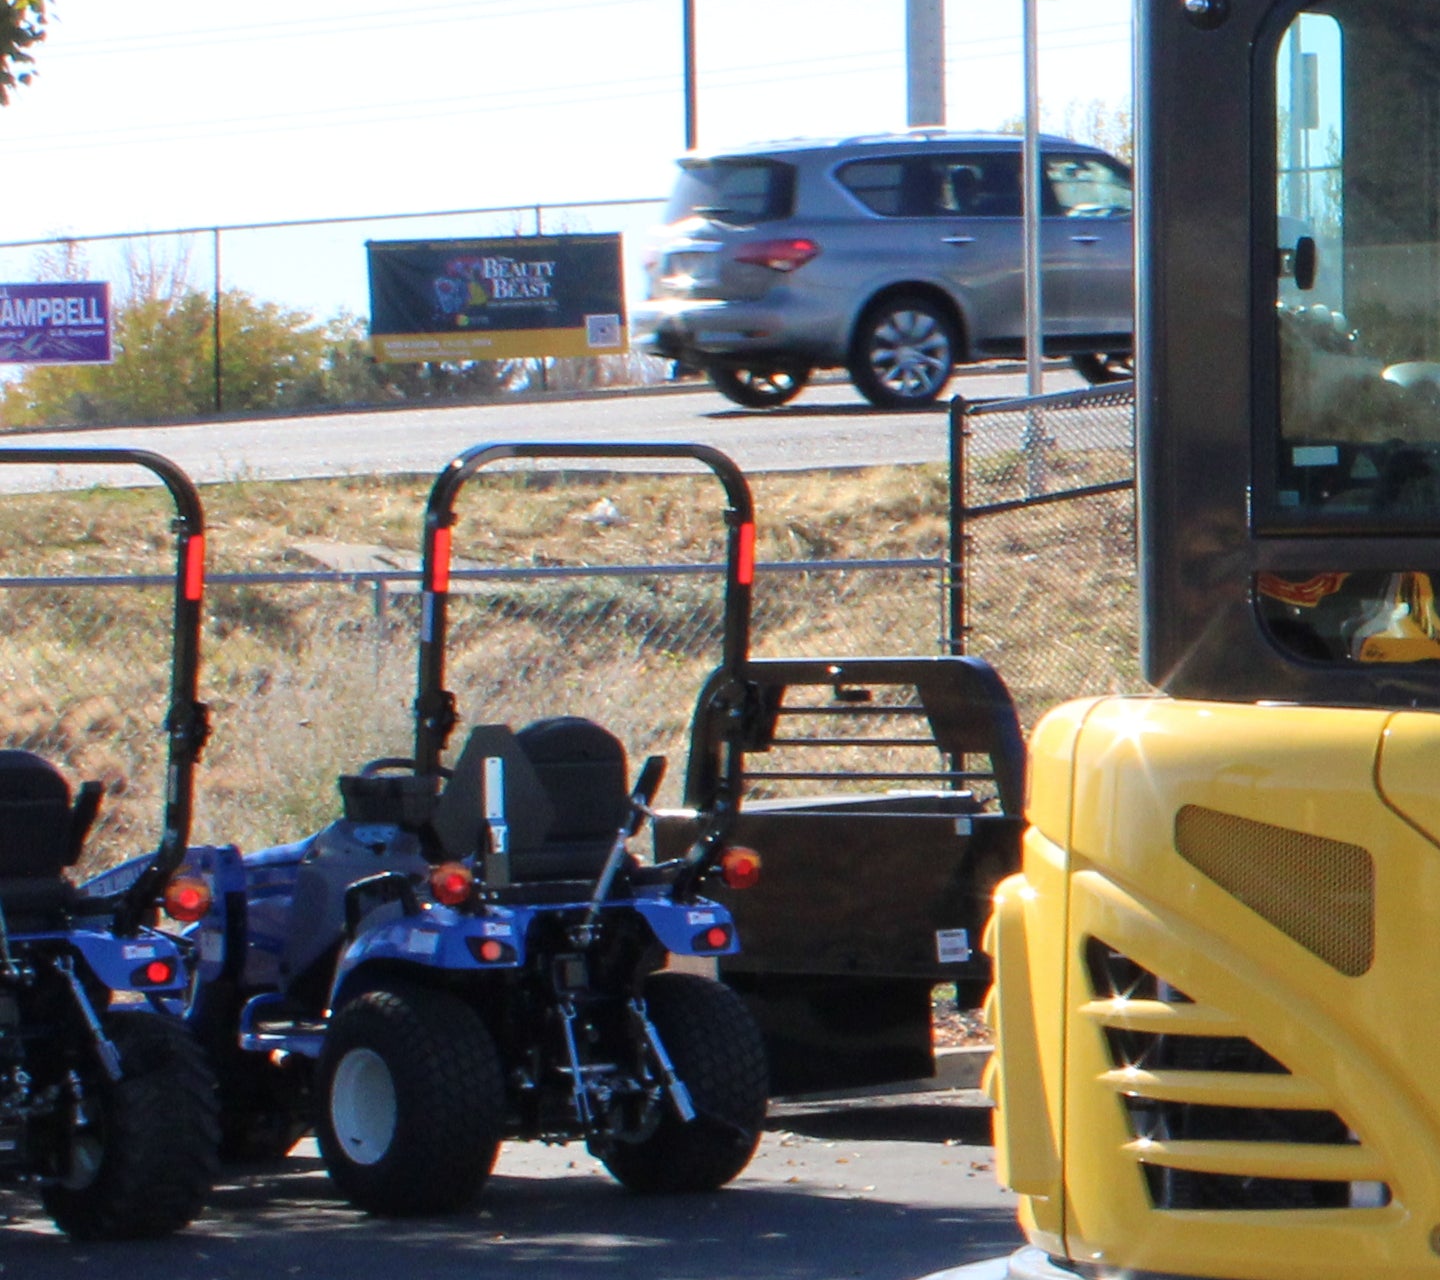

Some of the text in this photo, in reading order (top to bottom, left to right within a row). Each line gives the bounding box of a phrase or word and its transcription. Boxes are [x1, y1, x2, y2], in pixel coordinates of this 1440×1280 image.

[483, 257, 556, 279] BEAUTY
[493, 279, 551, 299] BEAST
[0, 296, 105, 327] AMPBELL
